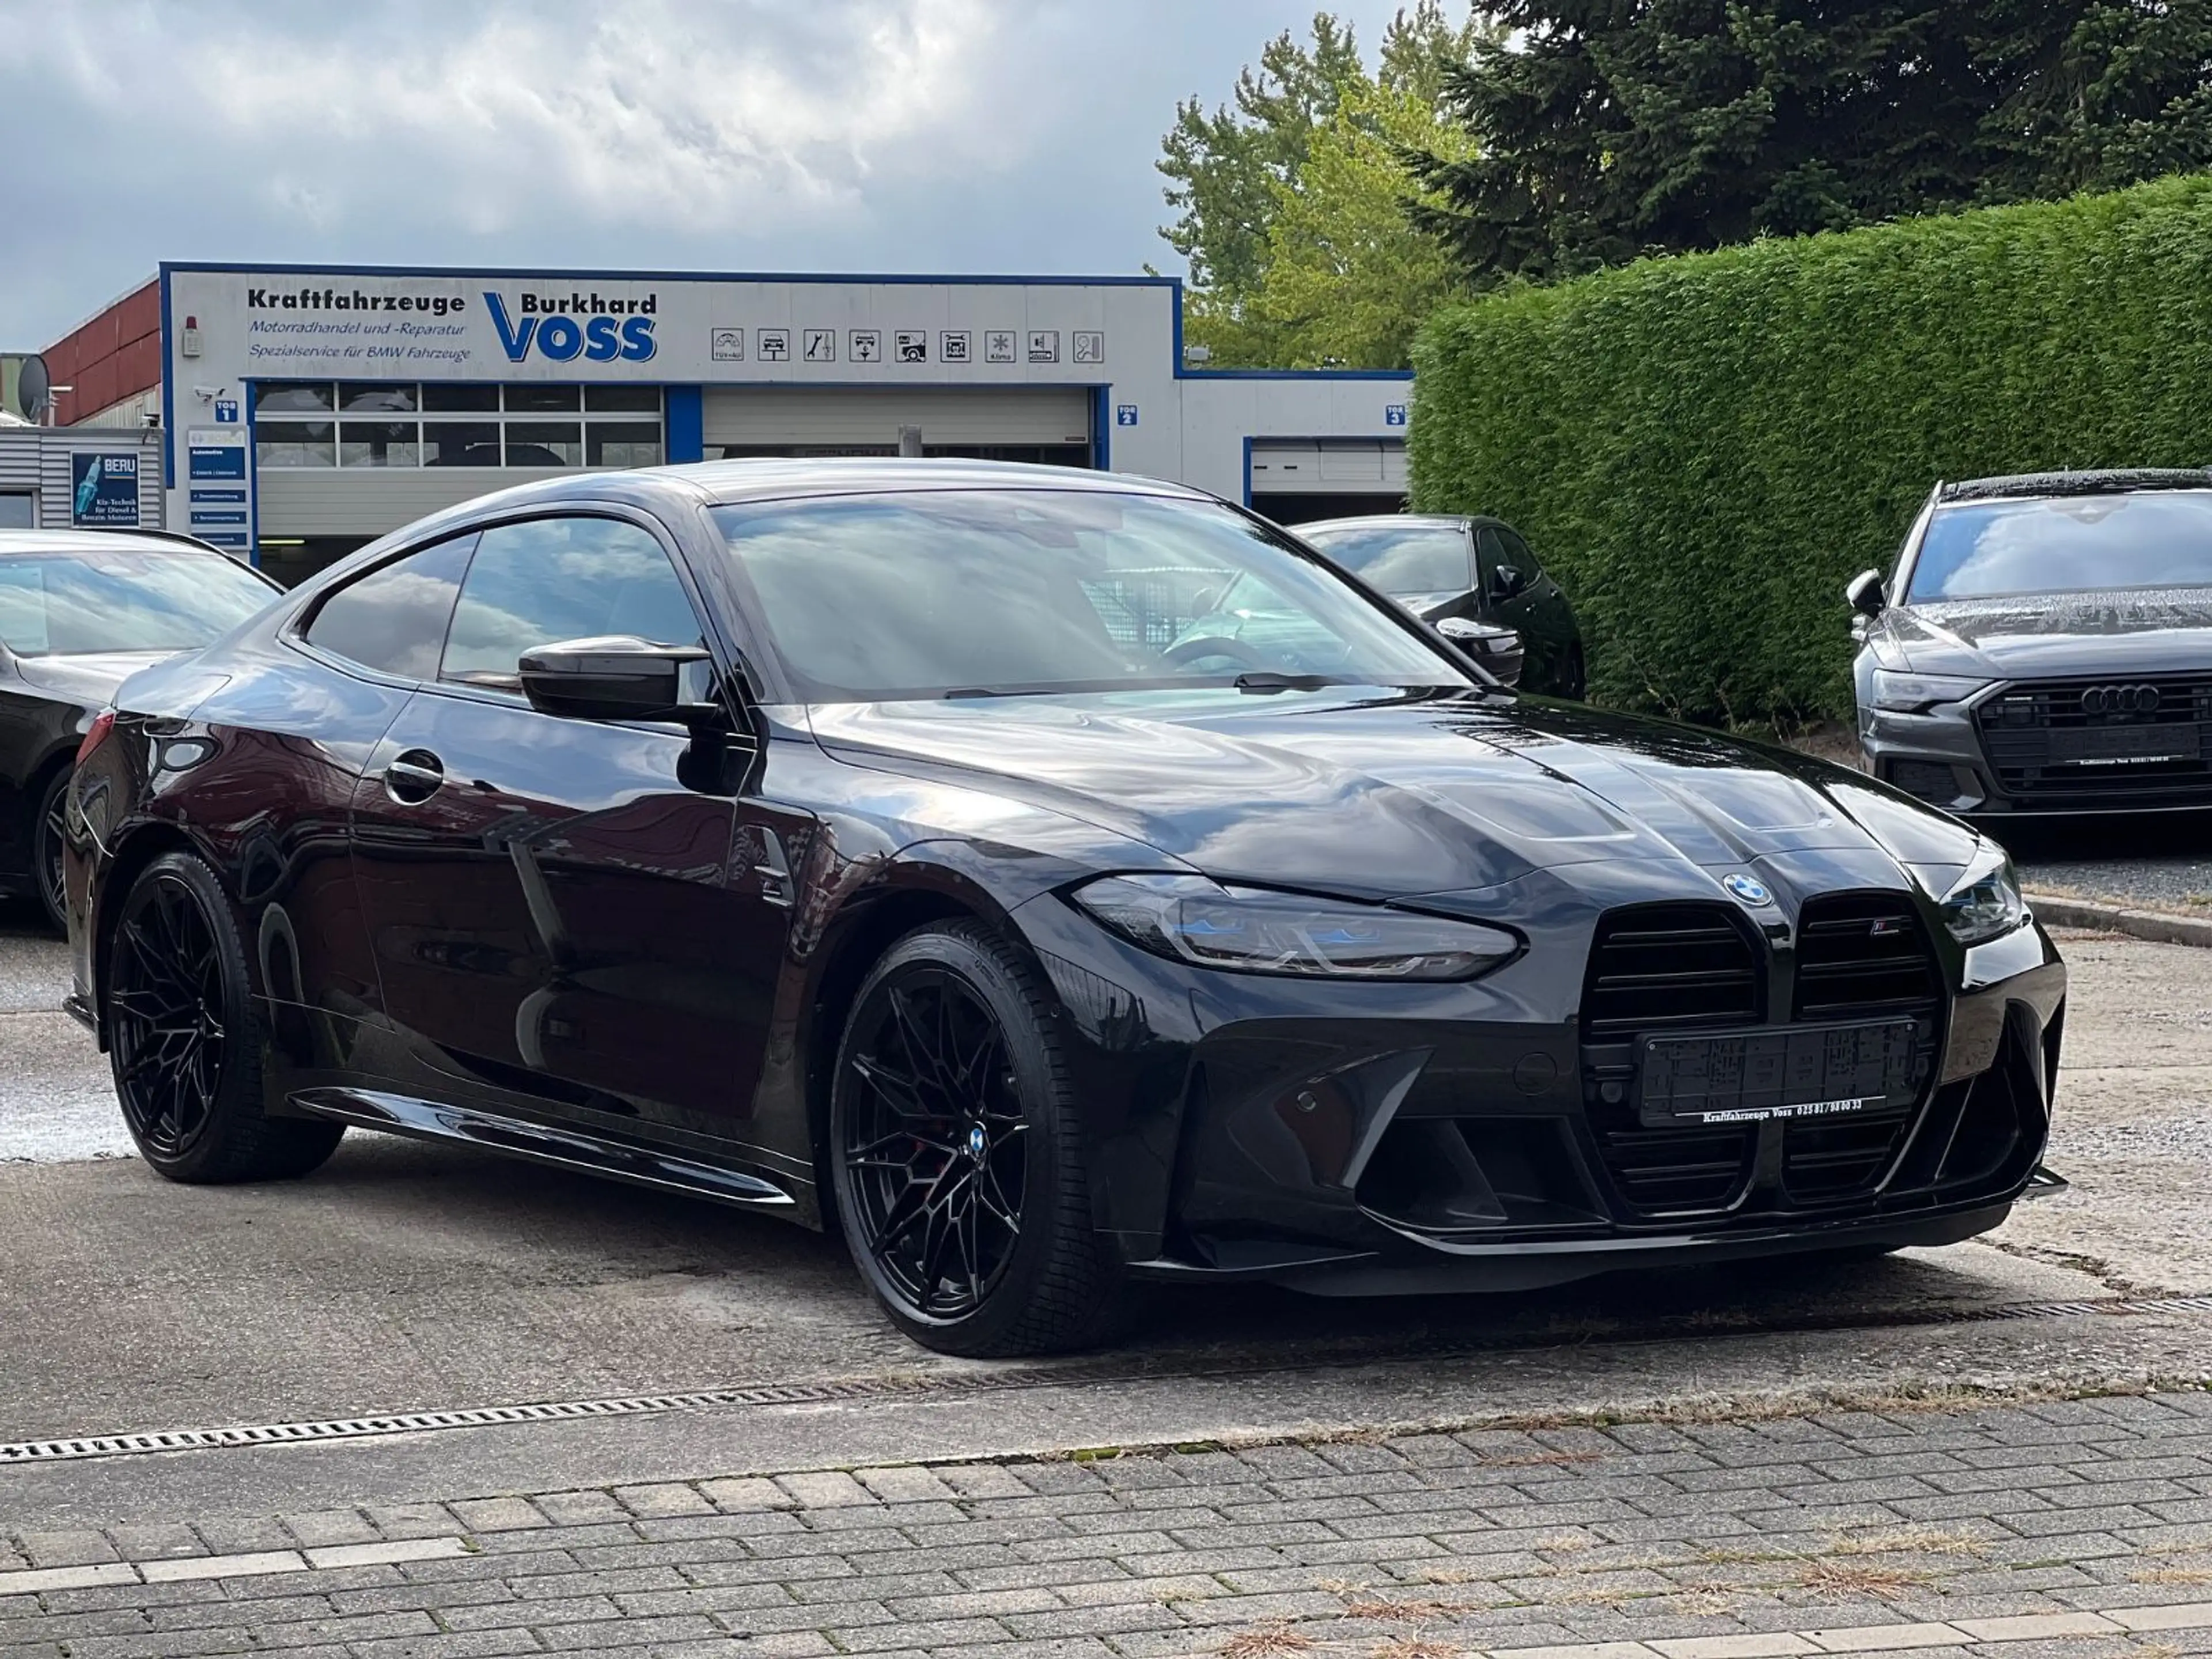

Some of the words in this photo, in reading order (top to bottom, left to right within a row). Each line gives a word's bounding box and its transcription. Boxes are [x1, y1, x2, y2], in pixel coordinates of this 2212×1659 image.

[248, 289, 465, 316] Kraftfahrzeuge
[521, 293, 657, 314] Burkhard
[250, 320, 361, 334] Motorradhandel
[363, 322, 391, 334] und
[393, 322, 466, 338] -Reparatur
[249, 344, 340, 358] Spezialservice
[343, 346, 365, 358] für
[366, 346, 404, 358] BMW
[407, 347, 471, 362] Fahrzeuge
[222, 410, 229, 421] 1
[1122, 414, 1132, 424] 2
[1391, 414, 1400, 424] 3
[104, 459, 136, 472] BERU
[1703, 1109, 1770, 1123] Kraftfahrzeuge
[1773, 1107, 1793, 1117] Voss
